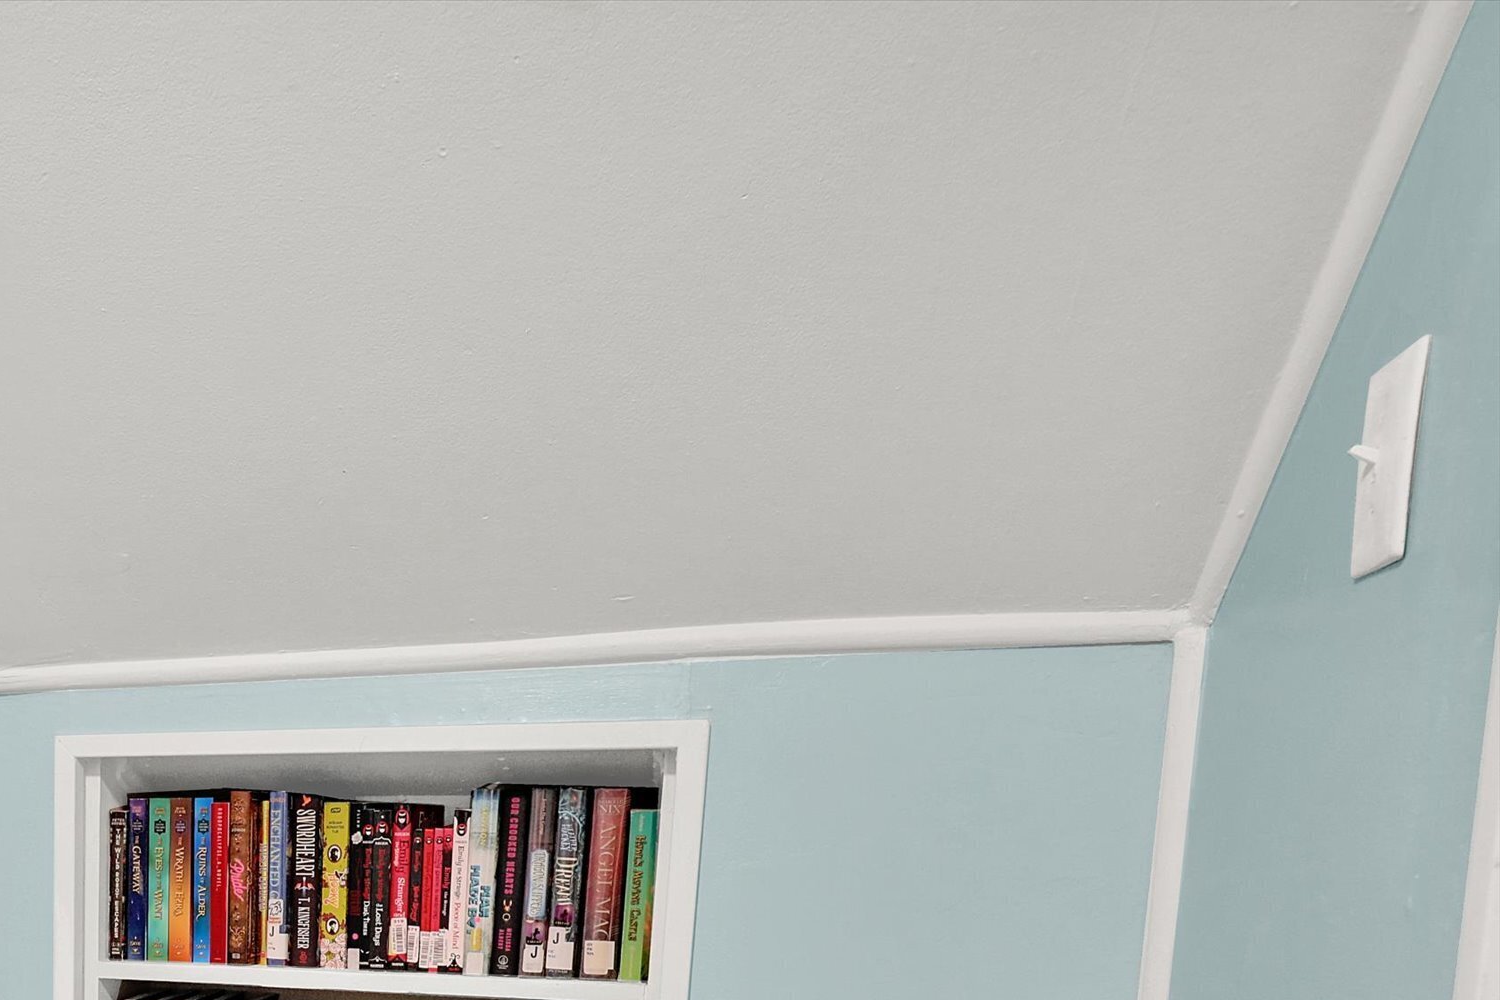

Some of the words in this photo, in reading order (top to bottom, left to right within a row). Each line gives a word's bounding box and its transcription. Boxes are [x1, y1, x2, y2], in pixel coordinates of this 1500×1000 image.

[509, 796, 521, 815] OUR
[269, 809, 282, 888] ENCHANTED
[295, 808, 317, 878] SWORDHEART
[506, 817, 519, 858] CROOKED
[131, 846, 142, 895] GATEWAY
[175, 846, 185, 883] WRATH
[196, 846, 207, 877] RUINS
[504, 861, 516, 896] HEARTS
[195, 885, 207, 922] ALDER
[375, 908, 384, 926] Lost
[296, 906, 311, 949] KINGFISHER
[373, 926, 383, 947] Days
